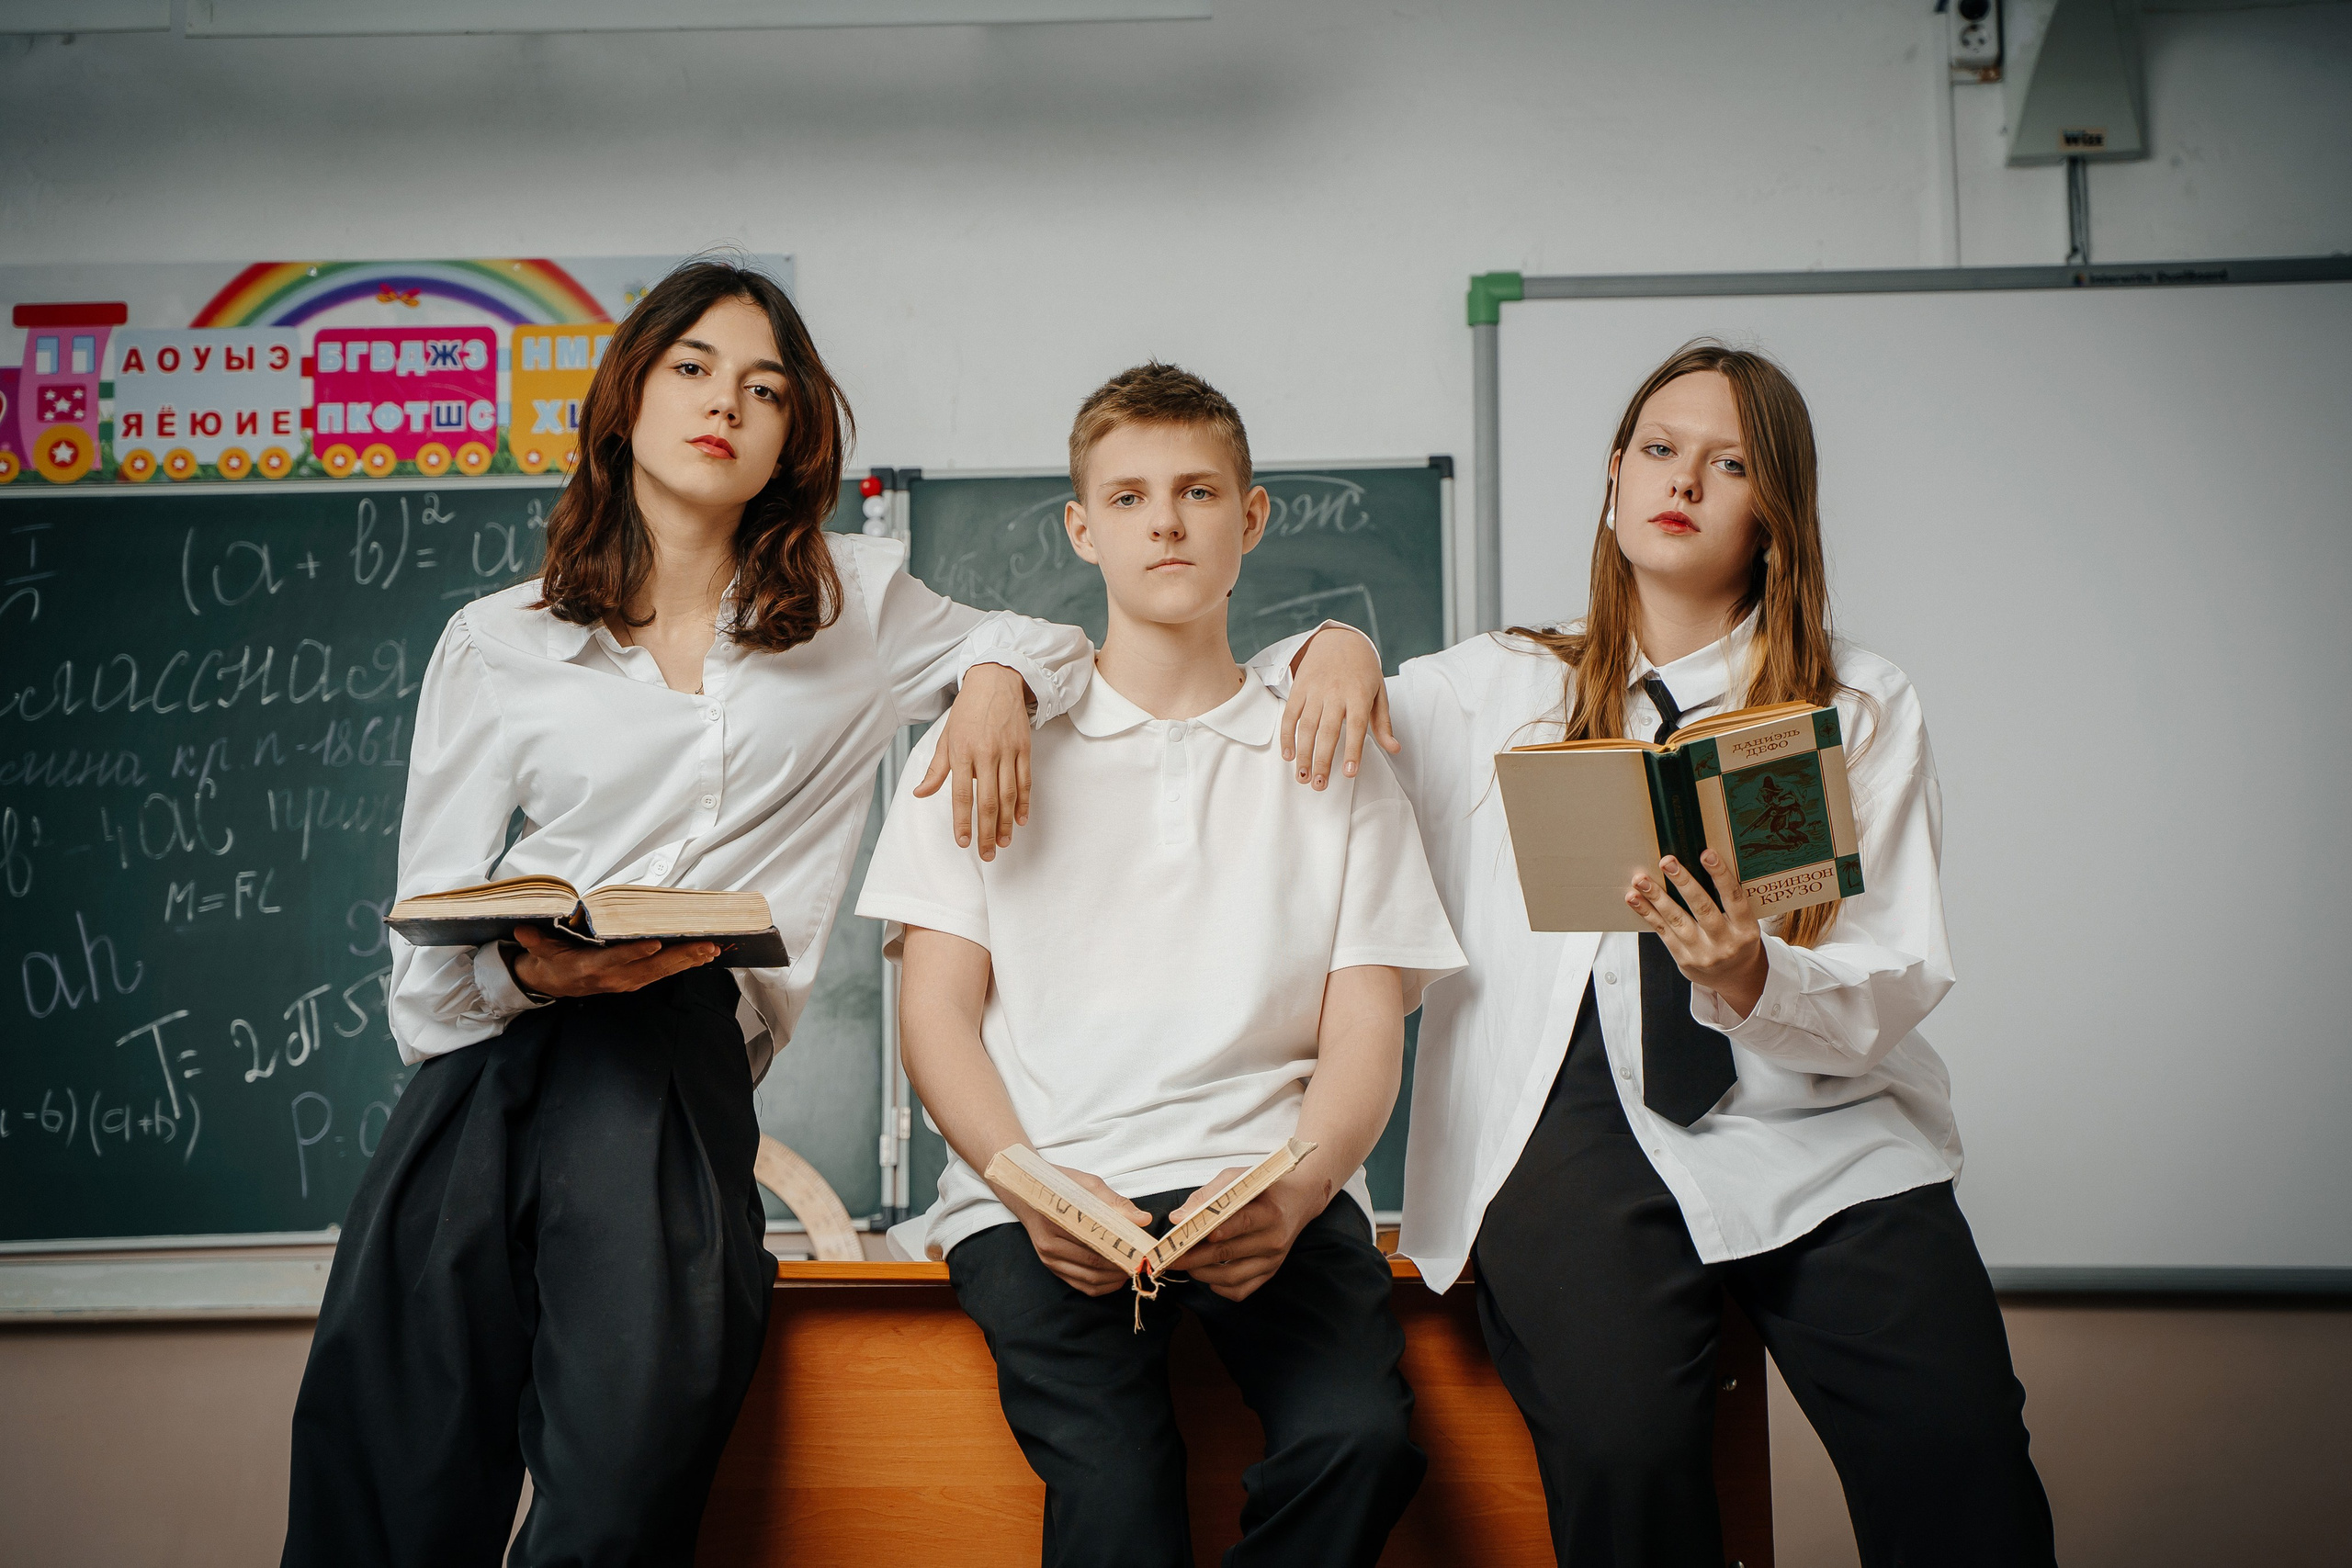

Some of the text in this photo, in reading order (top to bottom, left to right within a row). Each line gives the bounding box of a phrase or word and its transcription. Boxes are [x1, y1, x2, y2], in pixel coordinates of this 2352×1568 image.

[0, 638, 421, 721] лассная
[1746, 739, 1789, 759] ДЕФО
[1746, 867, 1835, 898] РОБИНЗОН
[1759, 882, 1824, 907] КРУЗО
